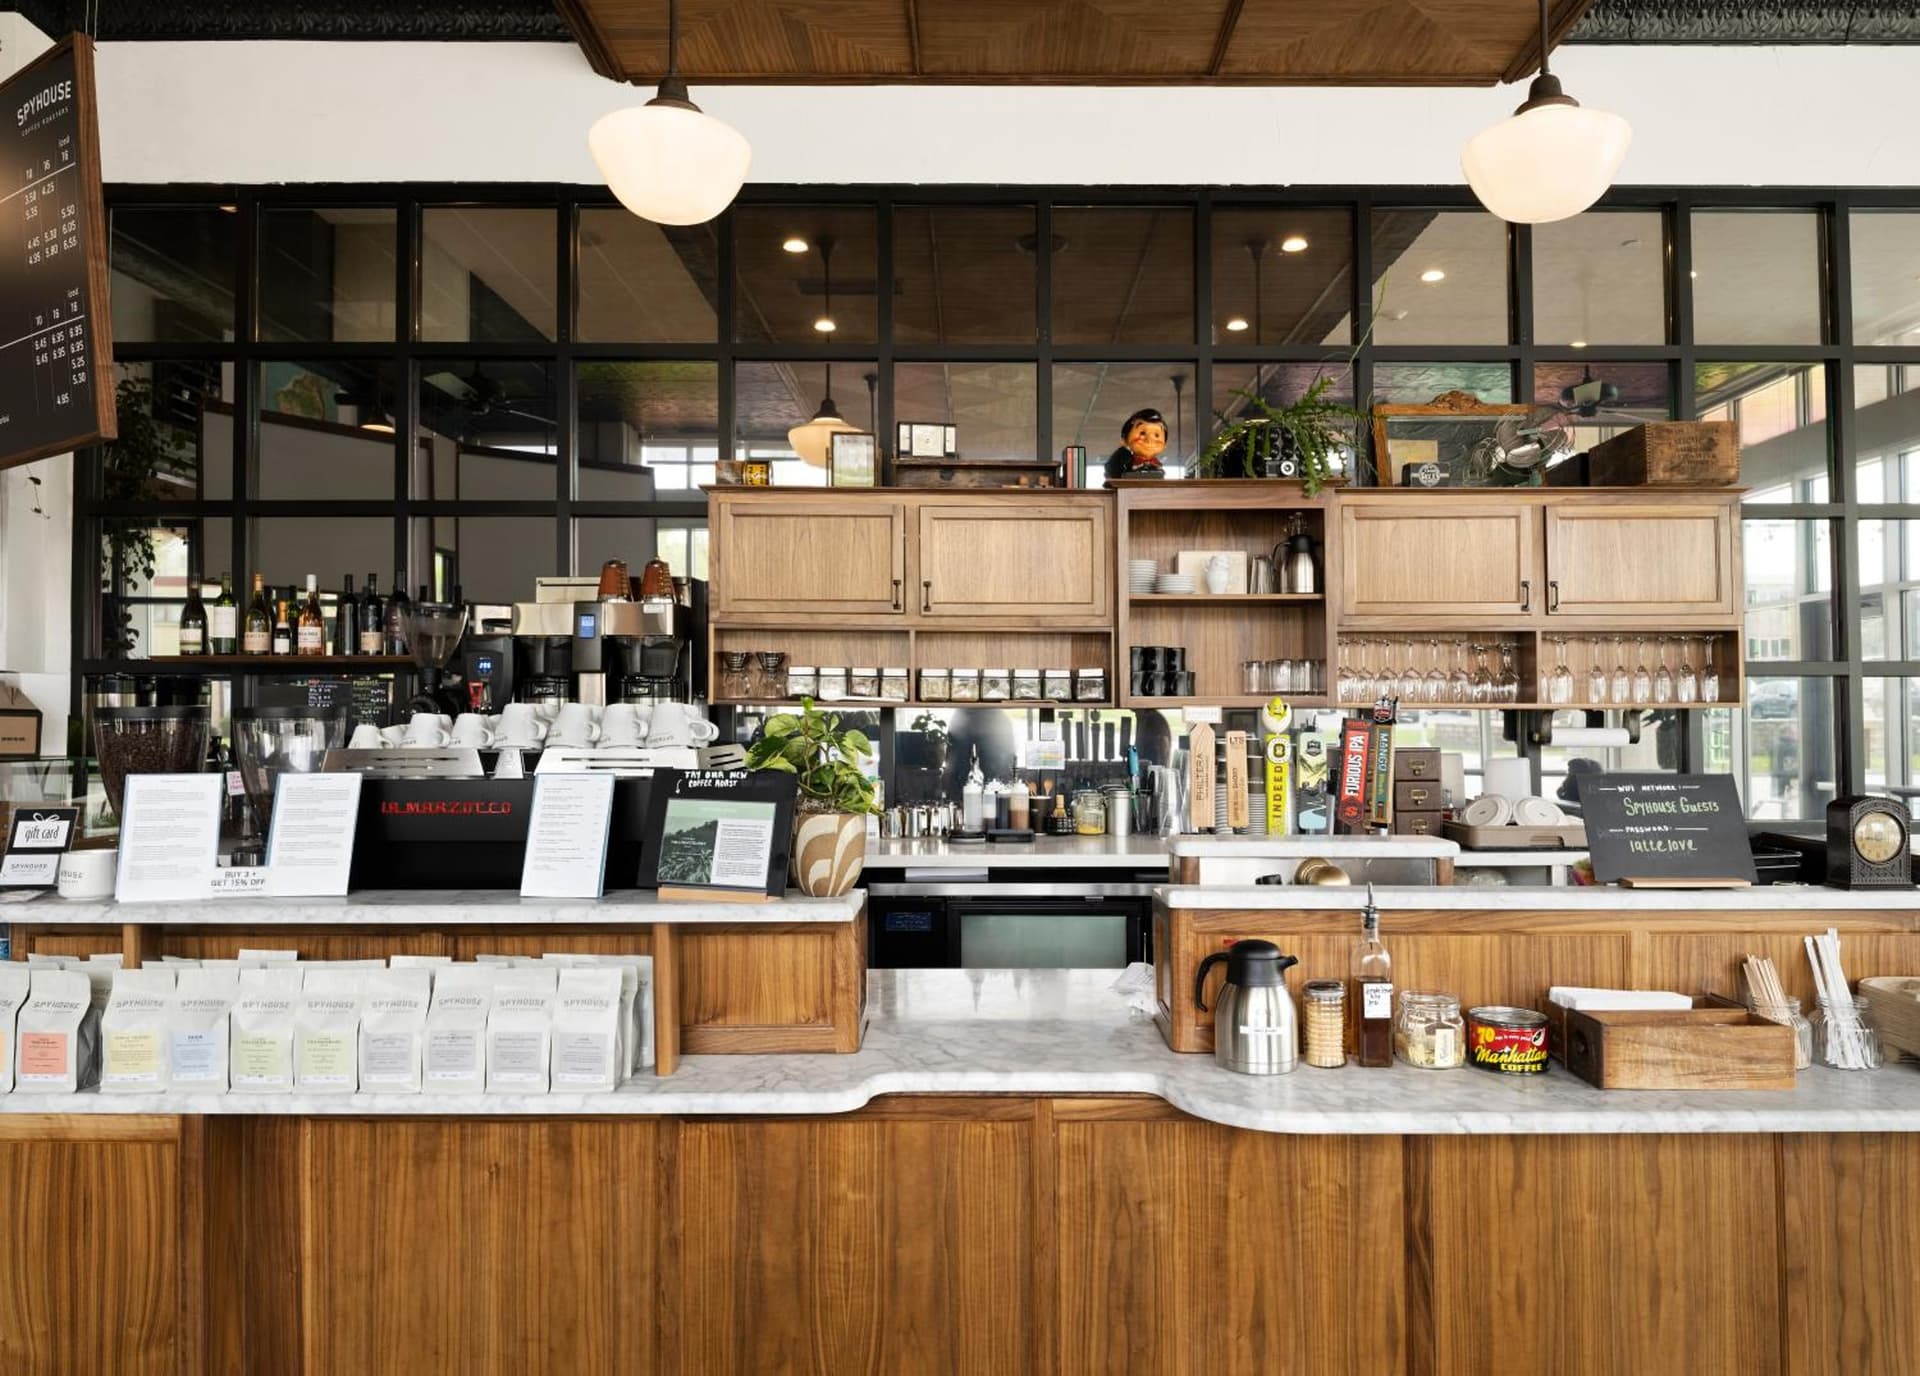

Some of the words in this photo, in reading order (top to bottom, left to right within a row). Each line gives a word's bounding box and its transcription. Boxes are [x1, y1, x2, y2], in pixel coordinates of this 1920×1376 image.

[17, 80, 71, 126] SPYHOUSE
[61, 204, 75, 218] 5.50
[62, 220, 76, 234] 6.05
[1349, 735, 1365, 751] IPA
[1378, 732, 1389, 771] MANGO
[1345, 754, 1363, 796] FURIOUS
[1272, 765, 1284, 819] INDEED
[25, 824, 40, 842] gift
[41, 825, 60, 839] card
[32, 1001, 81, 1009] SPYHOUSE
[1477, 1026, 1495, 1044] 70
[1501, 1063, 1543, 1071] COFFEE
